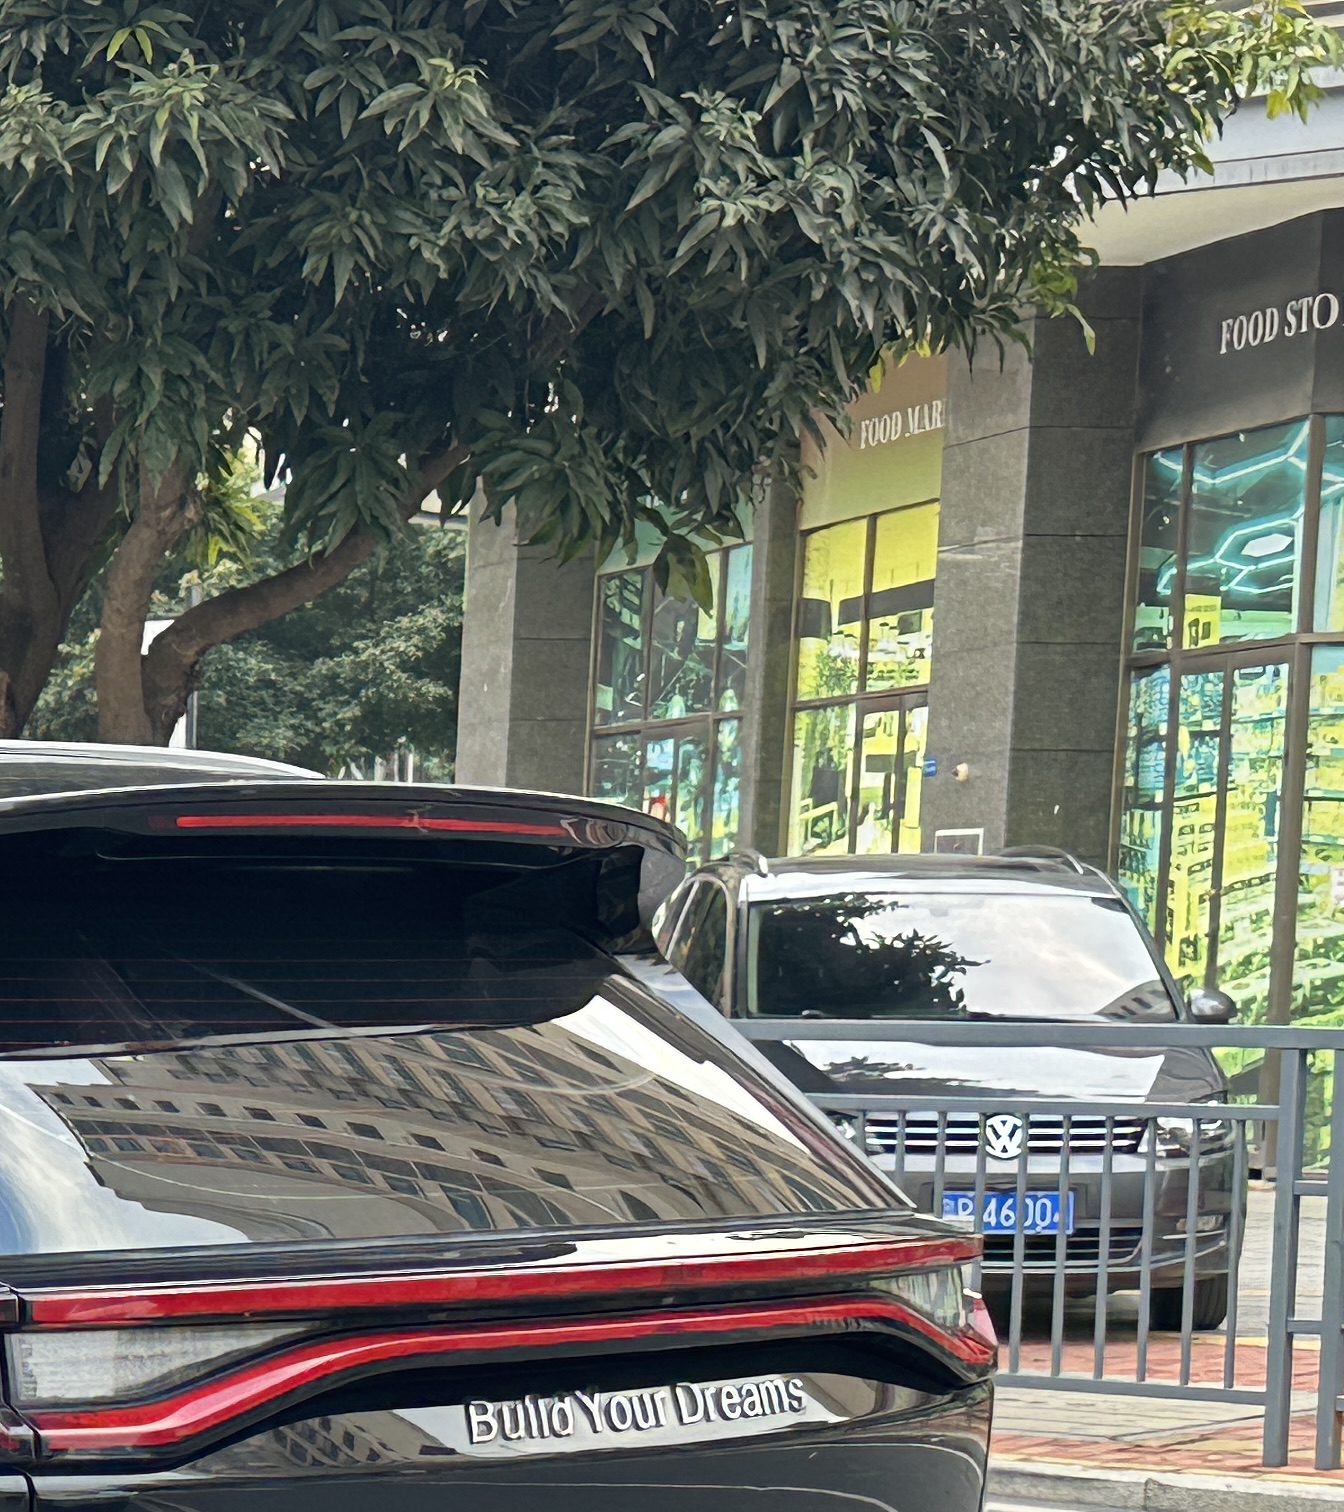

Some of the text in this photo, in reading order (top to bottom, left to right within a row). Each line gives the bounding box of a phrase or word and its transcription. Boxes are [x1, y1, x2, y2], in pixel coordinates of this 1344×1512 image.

[1219, 292, 1344, 355] FOOD STO
[859, 399, 946, 450] FOOD MAR
[468, 1376, 806, 1444] Build Your Dreams
